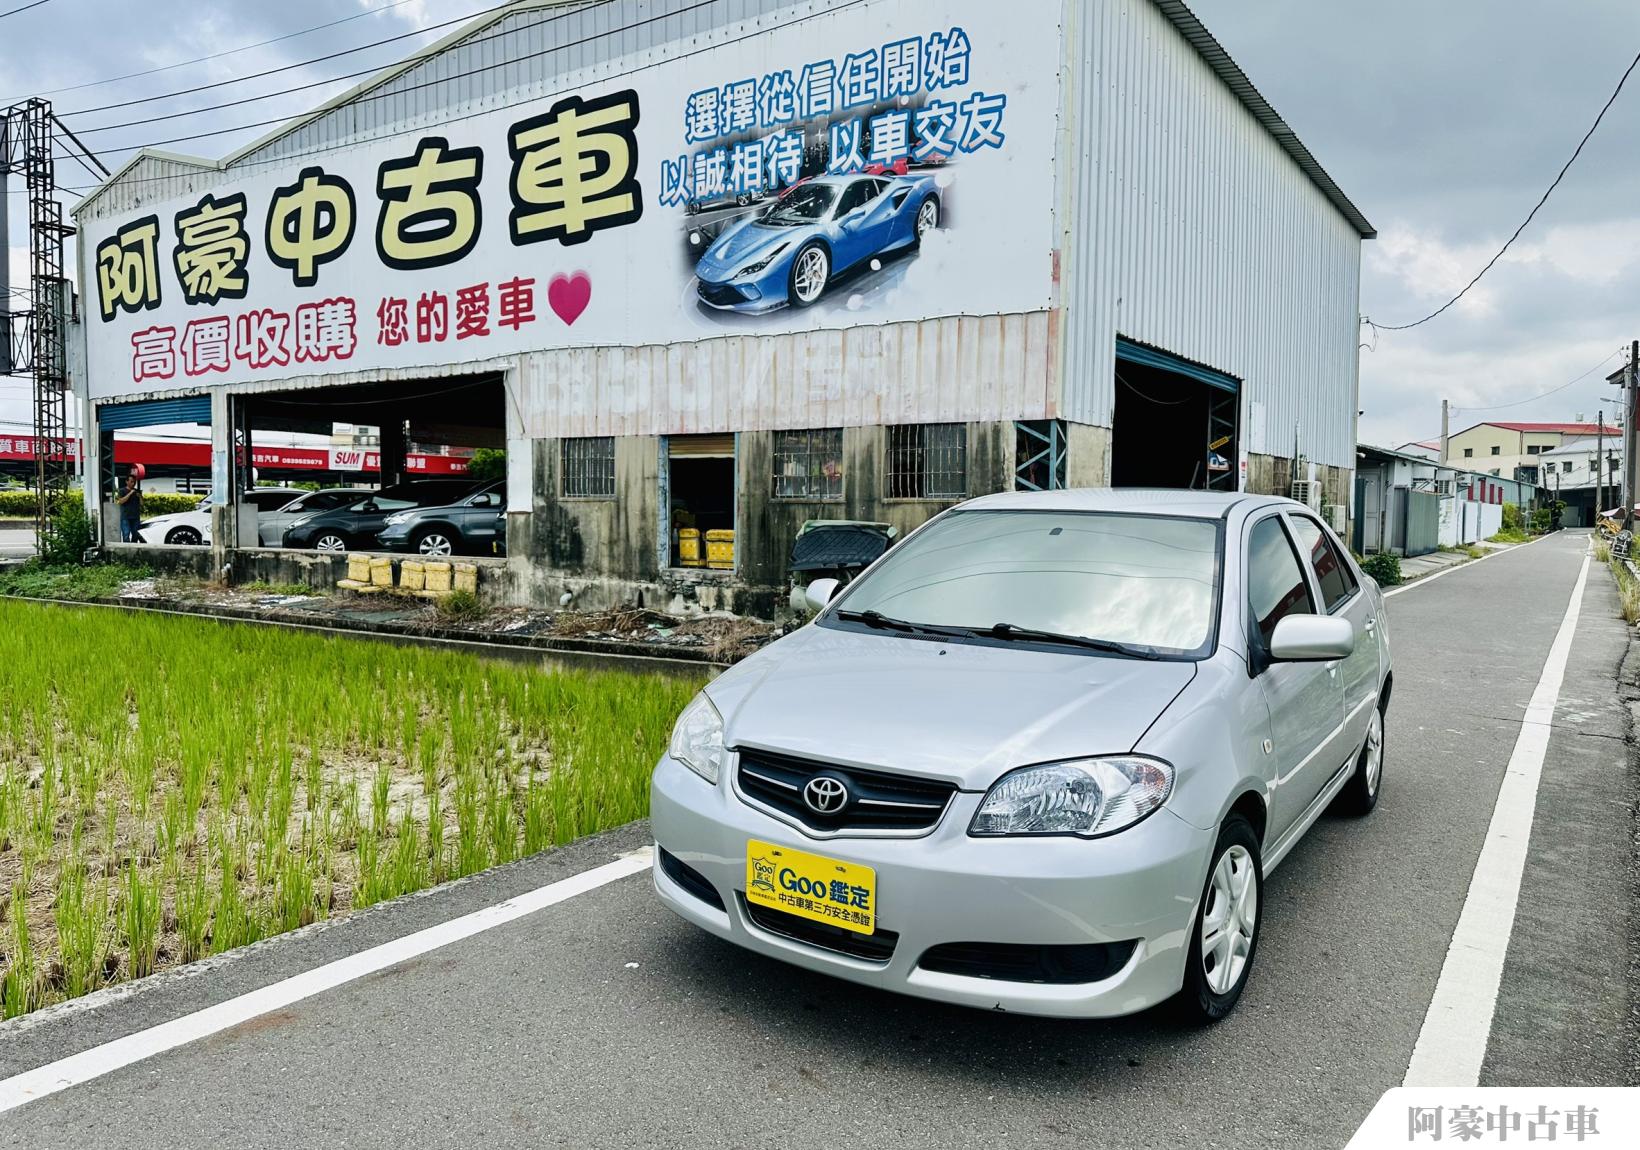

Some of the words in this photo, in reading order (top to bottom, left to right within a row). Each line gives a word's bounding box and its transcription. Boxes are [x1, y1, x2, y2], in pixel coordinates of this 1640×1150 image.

[685, 27, 971, 144] 選擇從信任開始
[659, 134, 804, 208] 以誠相待
[827, 92, 1007, 176] 以車交友
[97, 88, 644, 322] 阿豪中古車
[131, 296, 358, 383] 高價收購
[376, 276, 537, 346] 您的愛車
[335, 452, 360, 464] SUM
[755, 862, 773, 874] Goo
[779, 867, 826, 898] Goo
[829, 879, 870, 910] 鑑定
[778, 891, 870, 927] 中古車第三方安全憑證
